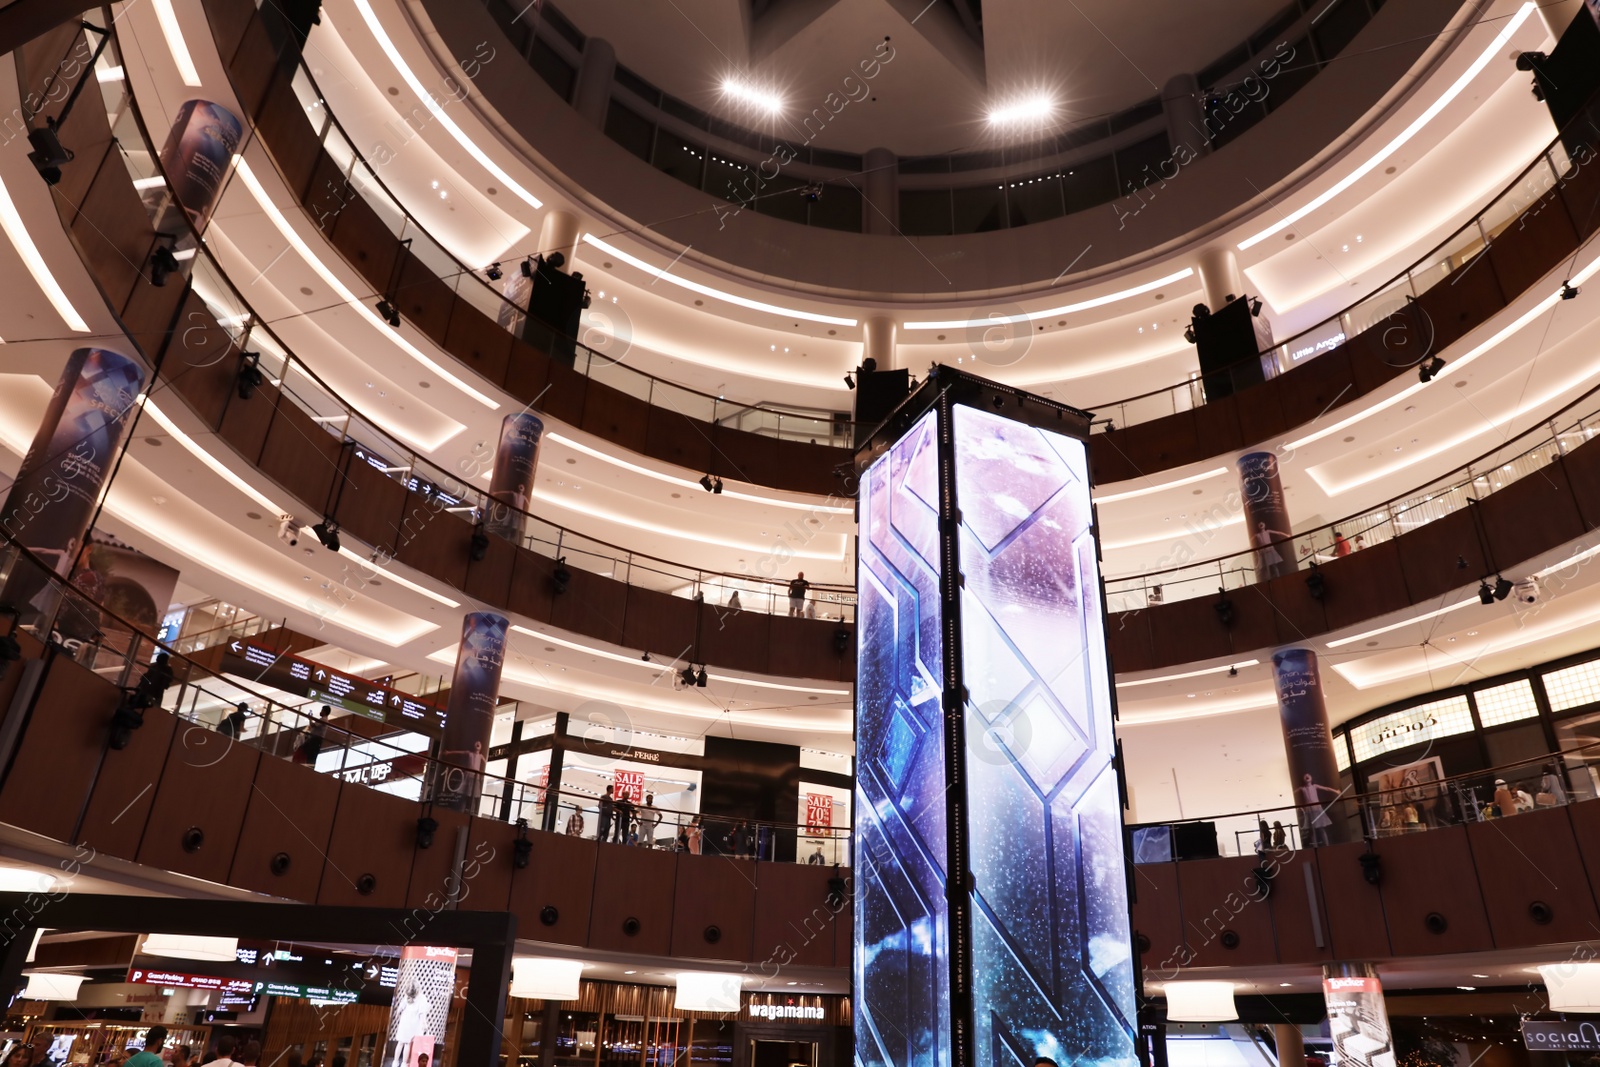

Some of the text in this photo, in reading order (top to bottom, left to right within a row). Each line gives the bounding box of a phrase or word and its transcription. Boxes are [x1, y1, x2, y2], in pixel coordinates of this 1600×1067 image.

[1292, 332, 1345, 360] Little Angels
[440, 766, 465, 792] 10
[615, 772, 643, 786] SALE
[807, 795, 832, 808] SALE
[147, 972, 165, 981] Grand
[164, 974, 185, 983] Parking
[267, 983, 284, 991] Cinema
[283, 985, 299, 994] Parking
[749, 1004, 825, 1020] wagamama
